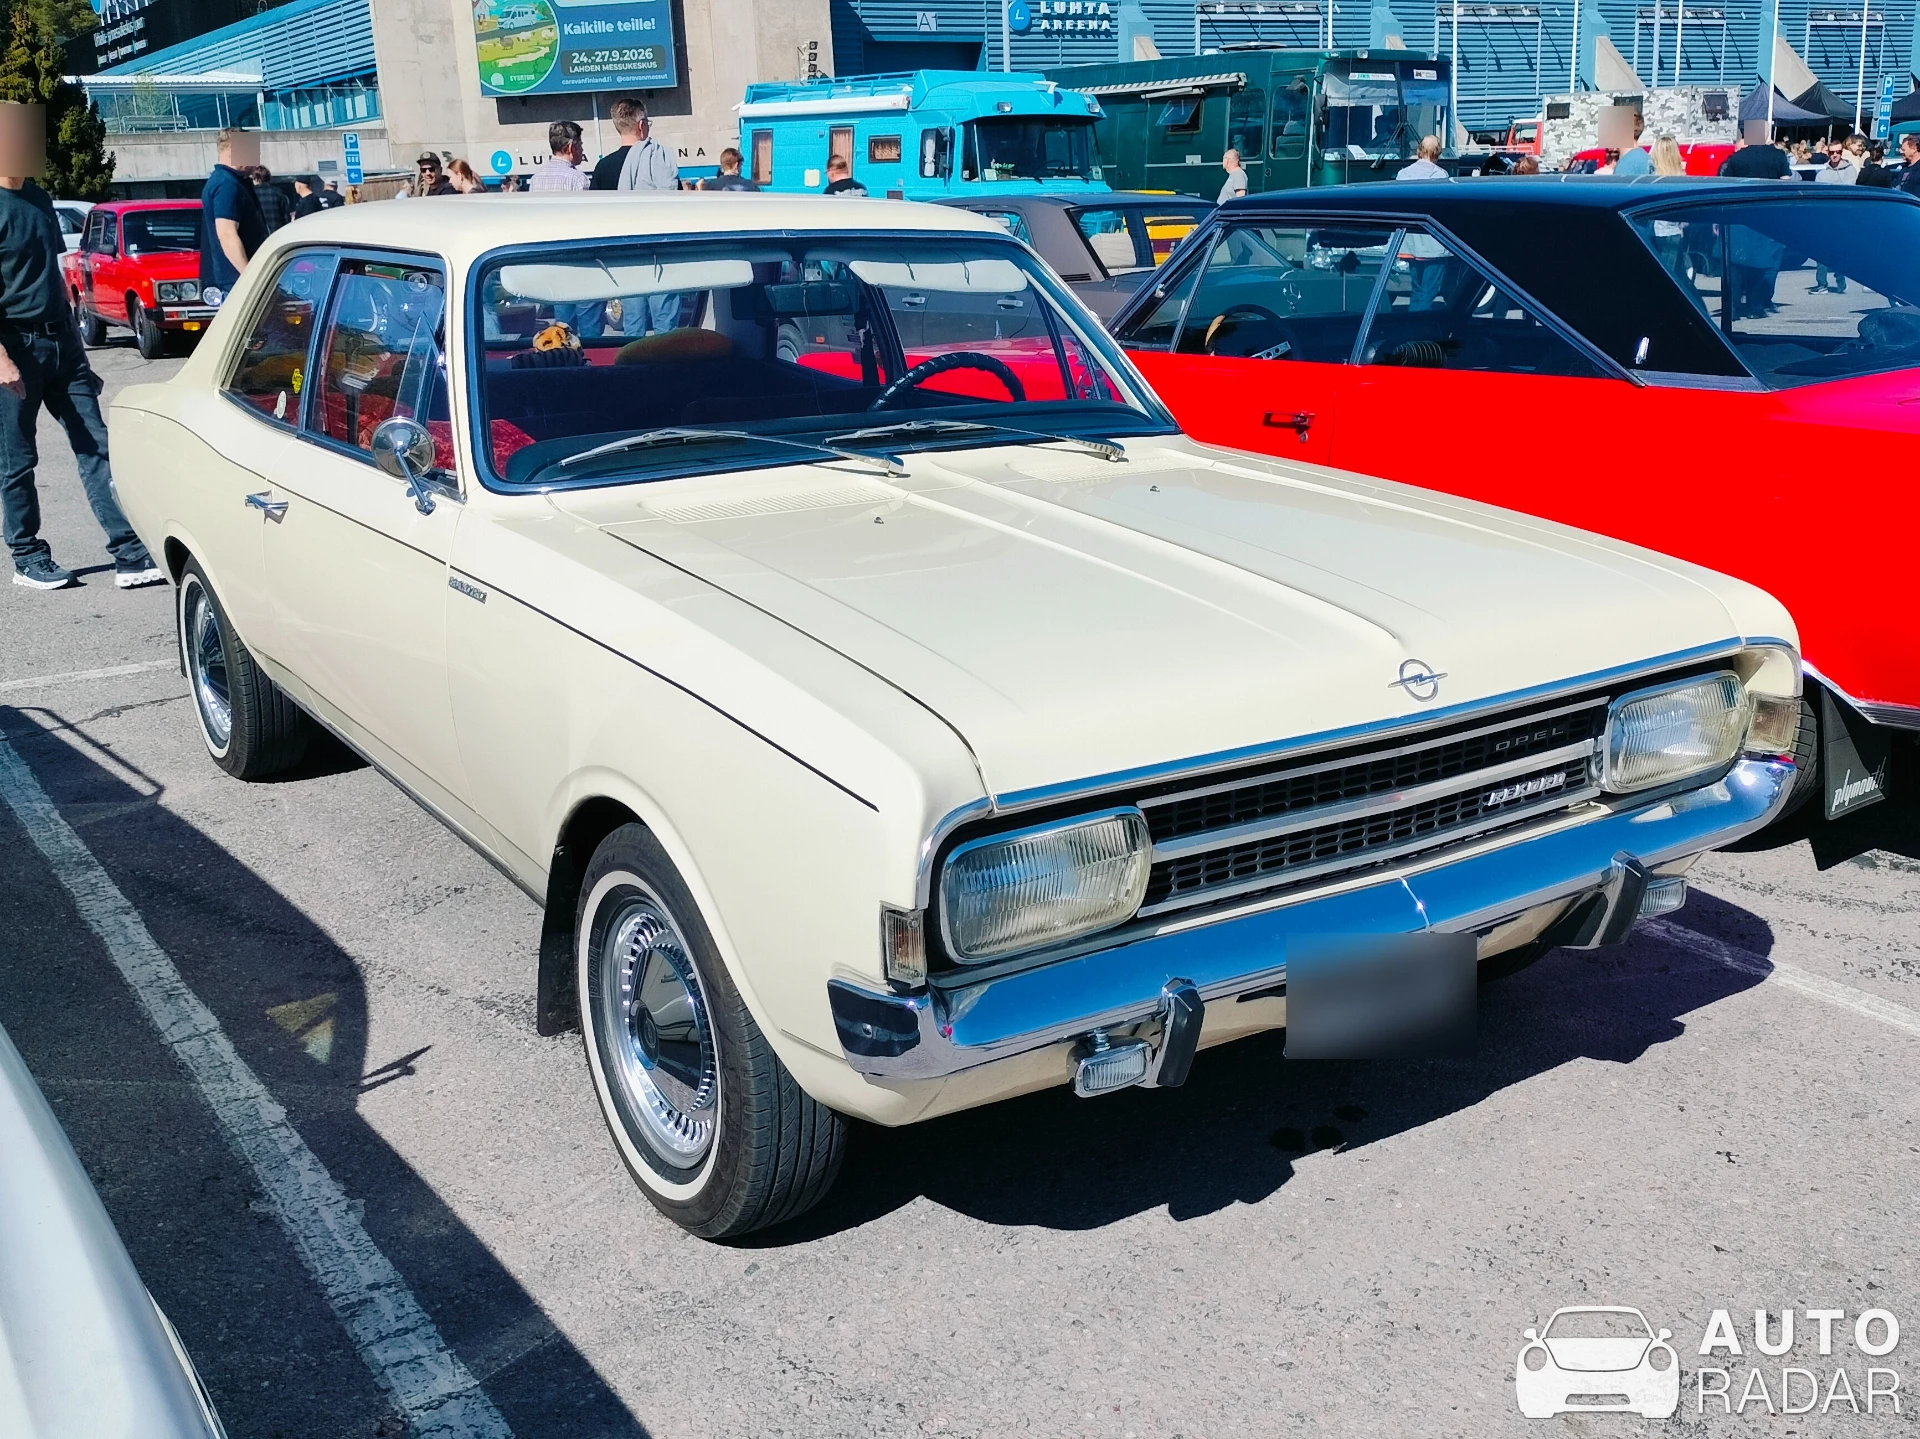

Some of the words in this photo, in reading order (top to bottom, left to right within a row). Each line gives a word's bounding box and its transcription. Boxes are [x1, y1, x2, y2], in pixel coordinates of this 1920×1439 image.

[1040, 1, 1111, 15] LUHTA
[563, 20, 615, 35] Kaikille
[616, 17, 656, 32] teille!
[918, 12, 938, 31] A1
[1040, 19, 1111, 30] AREENA
[571, 48, 654, 64] 24.-27.9.2026
[569, 64, 601, 73] LAHDEN
[602, 61, 658, 71] MESSUKESKUS
[1883, 77, 1893, 95] P
[345, 134, 357, 149] P
[519, 155, 589, 166] LUA
[1495, 727, 1564, 751] OPEL
[1487, 772, 1567, 807] REKORD
[1831, 756, 1887, 812] plymouth
